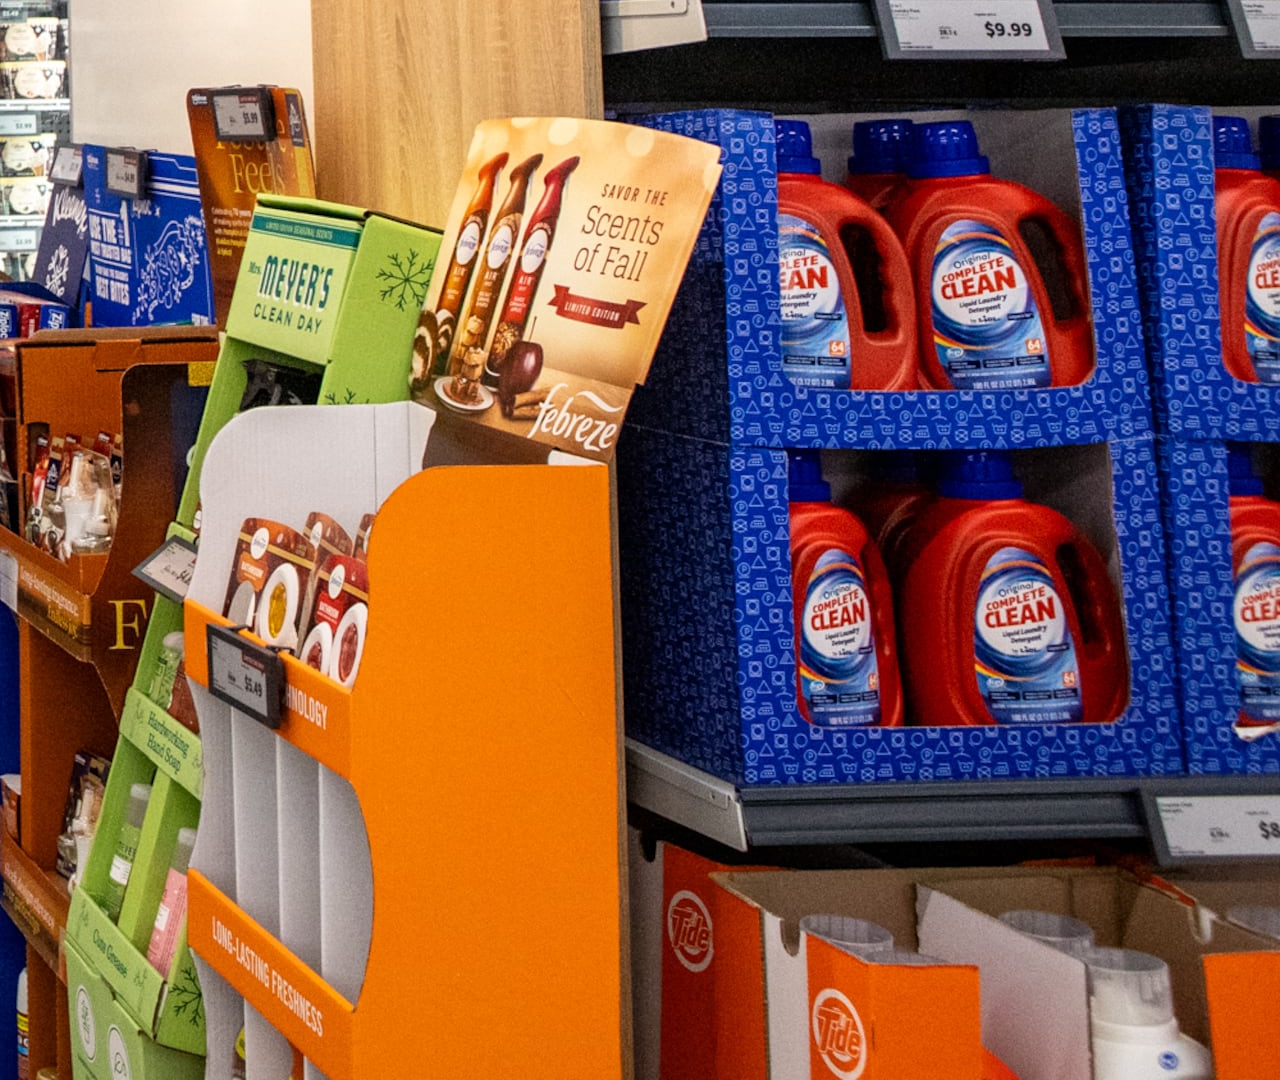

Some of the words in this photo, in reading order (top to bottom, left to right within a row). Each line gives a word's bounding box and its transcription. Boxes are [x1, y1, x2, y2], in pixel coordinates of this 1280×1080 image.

[985, 21, 1032, 38] $9.99
[229, 153, 286, 196] Feels
[601, 183, 638, 202] SAVOR
[645, 189, 669, 207] THE
[581, 204, 665, 246] Scents
[574, 244, 602, 273] of
[604, 249, 649, 282] Fall
[942, 257, 1004, 282] COMPLETE
[953, 253, 990, 269] Original
[259, 255, 334, 310] MEYER'S
[780, 266, 828, 291] EAN
[941, 267, 1016, 300] CLEAN
[1255, 270, 1280, 290] CLE
[564, 300, 590, 317] LIMITED
[591, 305, 620, 322] EDITION
[780, 300, 810, 309] etergent
[959, 299, 977, 309] Liquid
[978, 294, 1007, 306] Laundry
[968, 304, 1001, 314] Detergent
[254, 303, 294, 327] CLEAN
[297, 314, 322, 335] DAY
[830, 342, 845, 353] 64
[1028, 340, 1040, 350] 64
[527, 382, 621, 453] febreze
[812, 590, 860, 613] COMPLETE
[823, 584, 851, 600] Original
[986, 586, 1046, 611] COMPLETE
[998, 582, 1034, 598] Original
[811, 599, 865, 631] CLEAN
[985, 597, 1056, 629] CLEAN
[244, 673, 262, 698] $5.49
[286, 684, 328, 731] HNOLOGY
[148, 711, 190, 759] Hardworking
[147, 732, 164, 755] Hand
[164, 750, 181, 775] Soap
[668, 906, 711, 952] Tide
[212, 915, 270, 988] LONG-LASTING
[271, 966, 324, 1039] FRESHNESS
[818, 1005, 863, 1060] Tide
